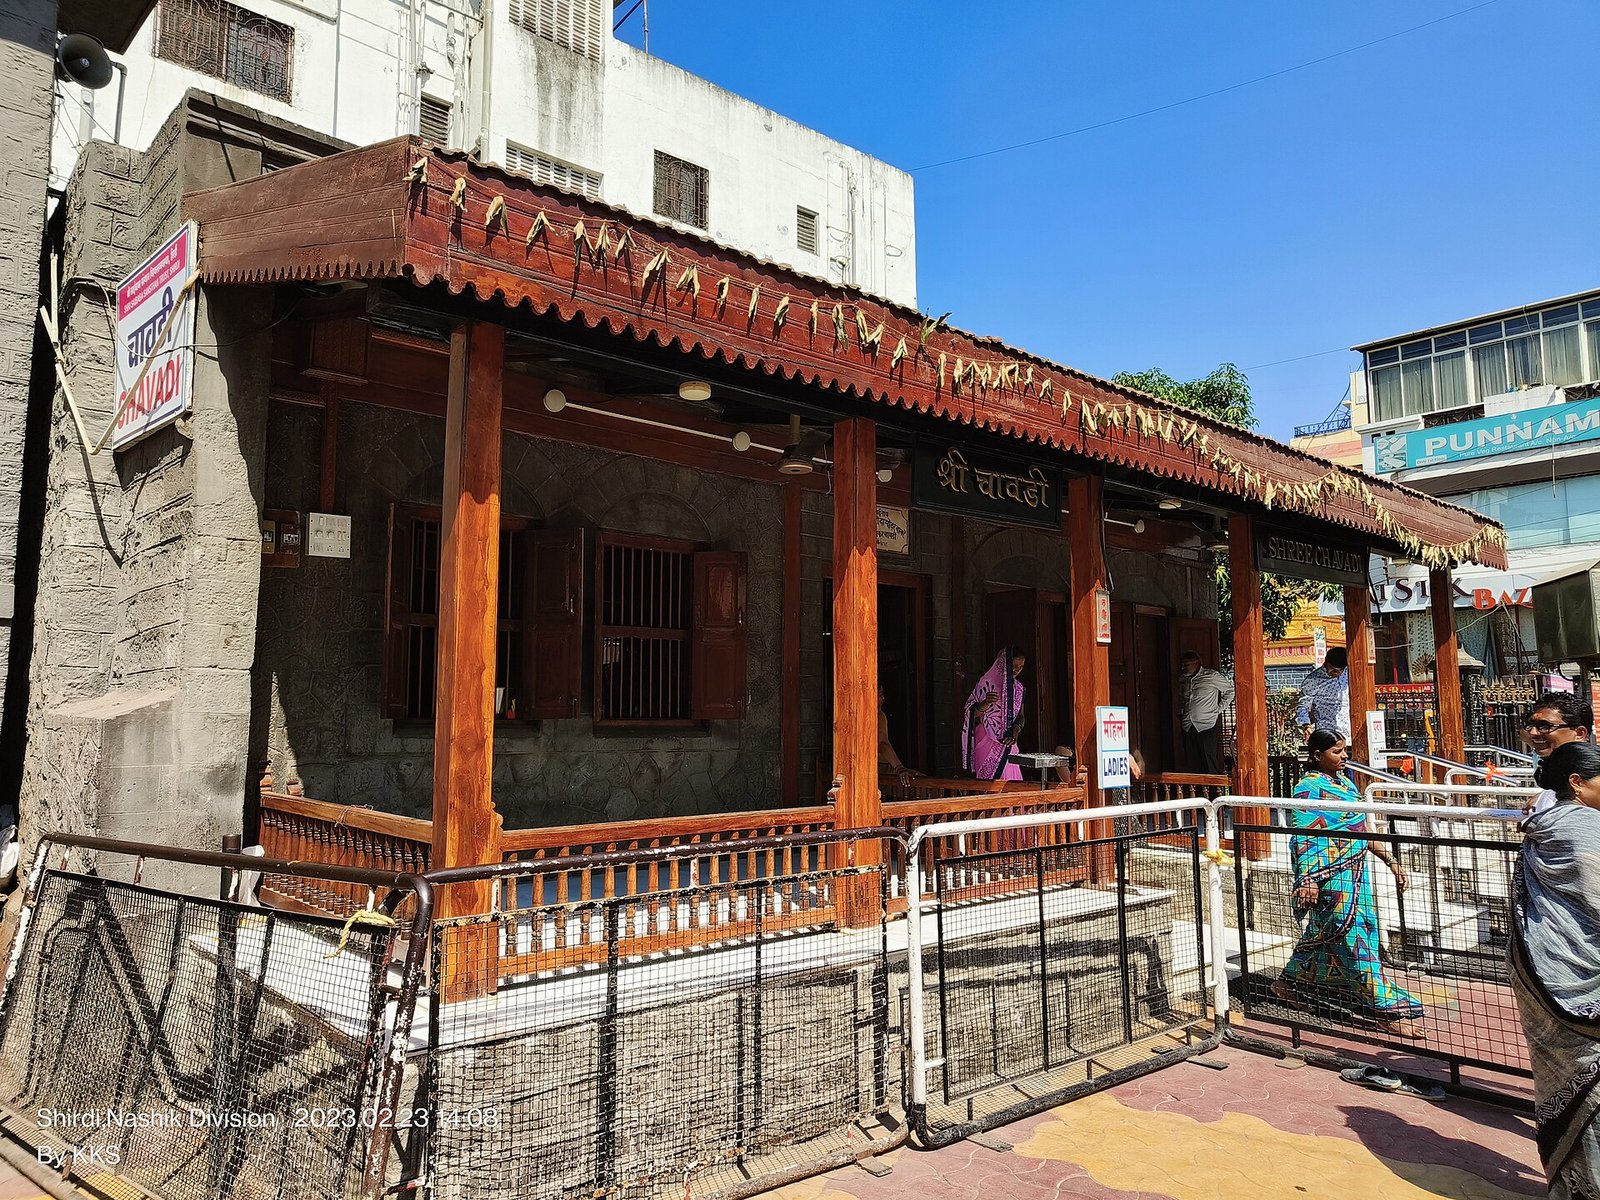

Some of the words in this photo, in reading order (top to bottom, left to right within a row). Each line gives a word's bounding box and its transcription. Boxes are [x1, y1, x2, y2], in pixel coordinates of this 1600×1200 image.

[117, 354, 181, 429] CHAVADI
[1425, 410, 1600, 457] PUNNAM
[936, 446, 968, 493] श्री
[974, 465, 1050, 507] चावडी
[1268, 536, 1313, 564] SHREE
[1315, 546, 1363, 573] CHAVADI
[1471, 587, 1534, 610] BAZ
[1103, 712, 1126, 741] महिला
[1104, 757, 1128, 776] LADIES
